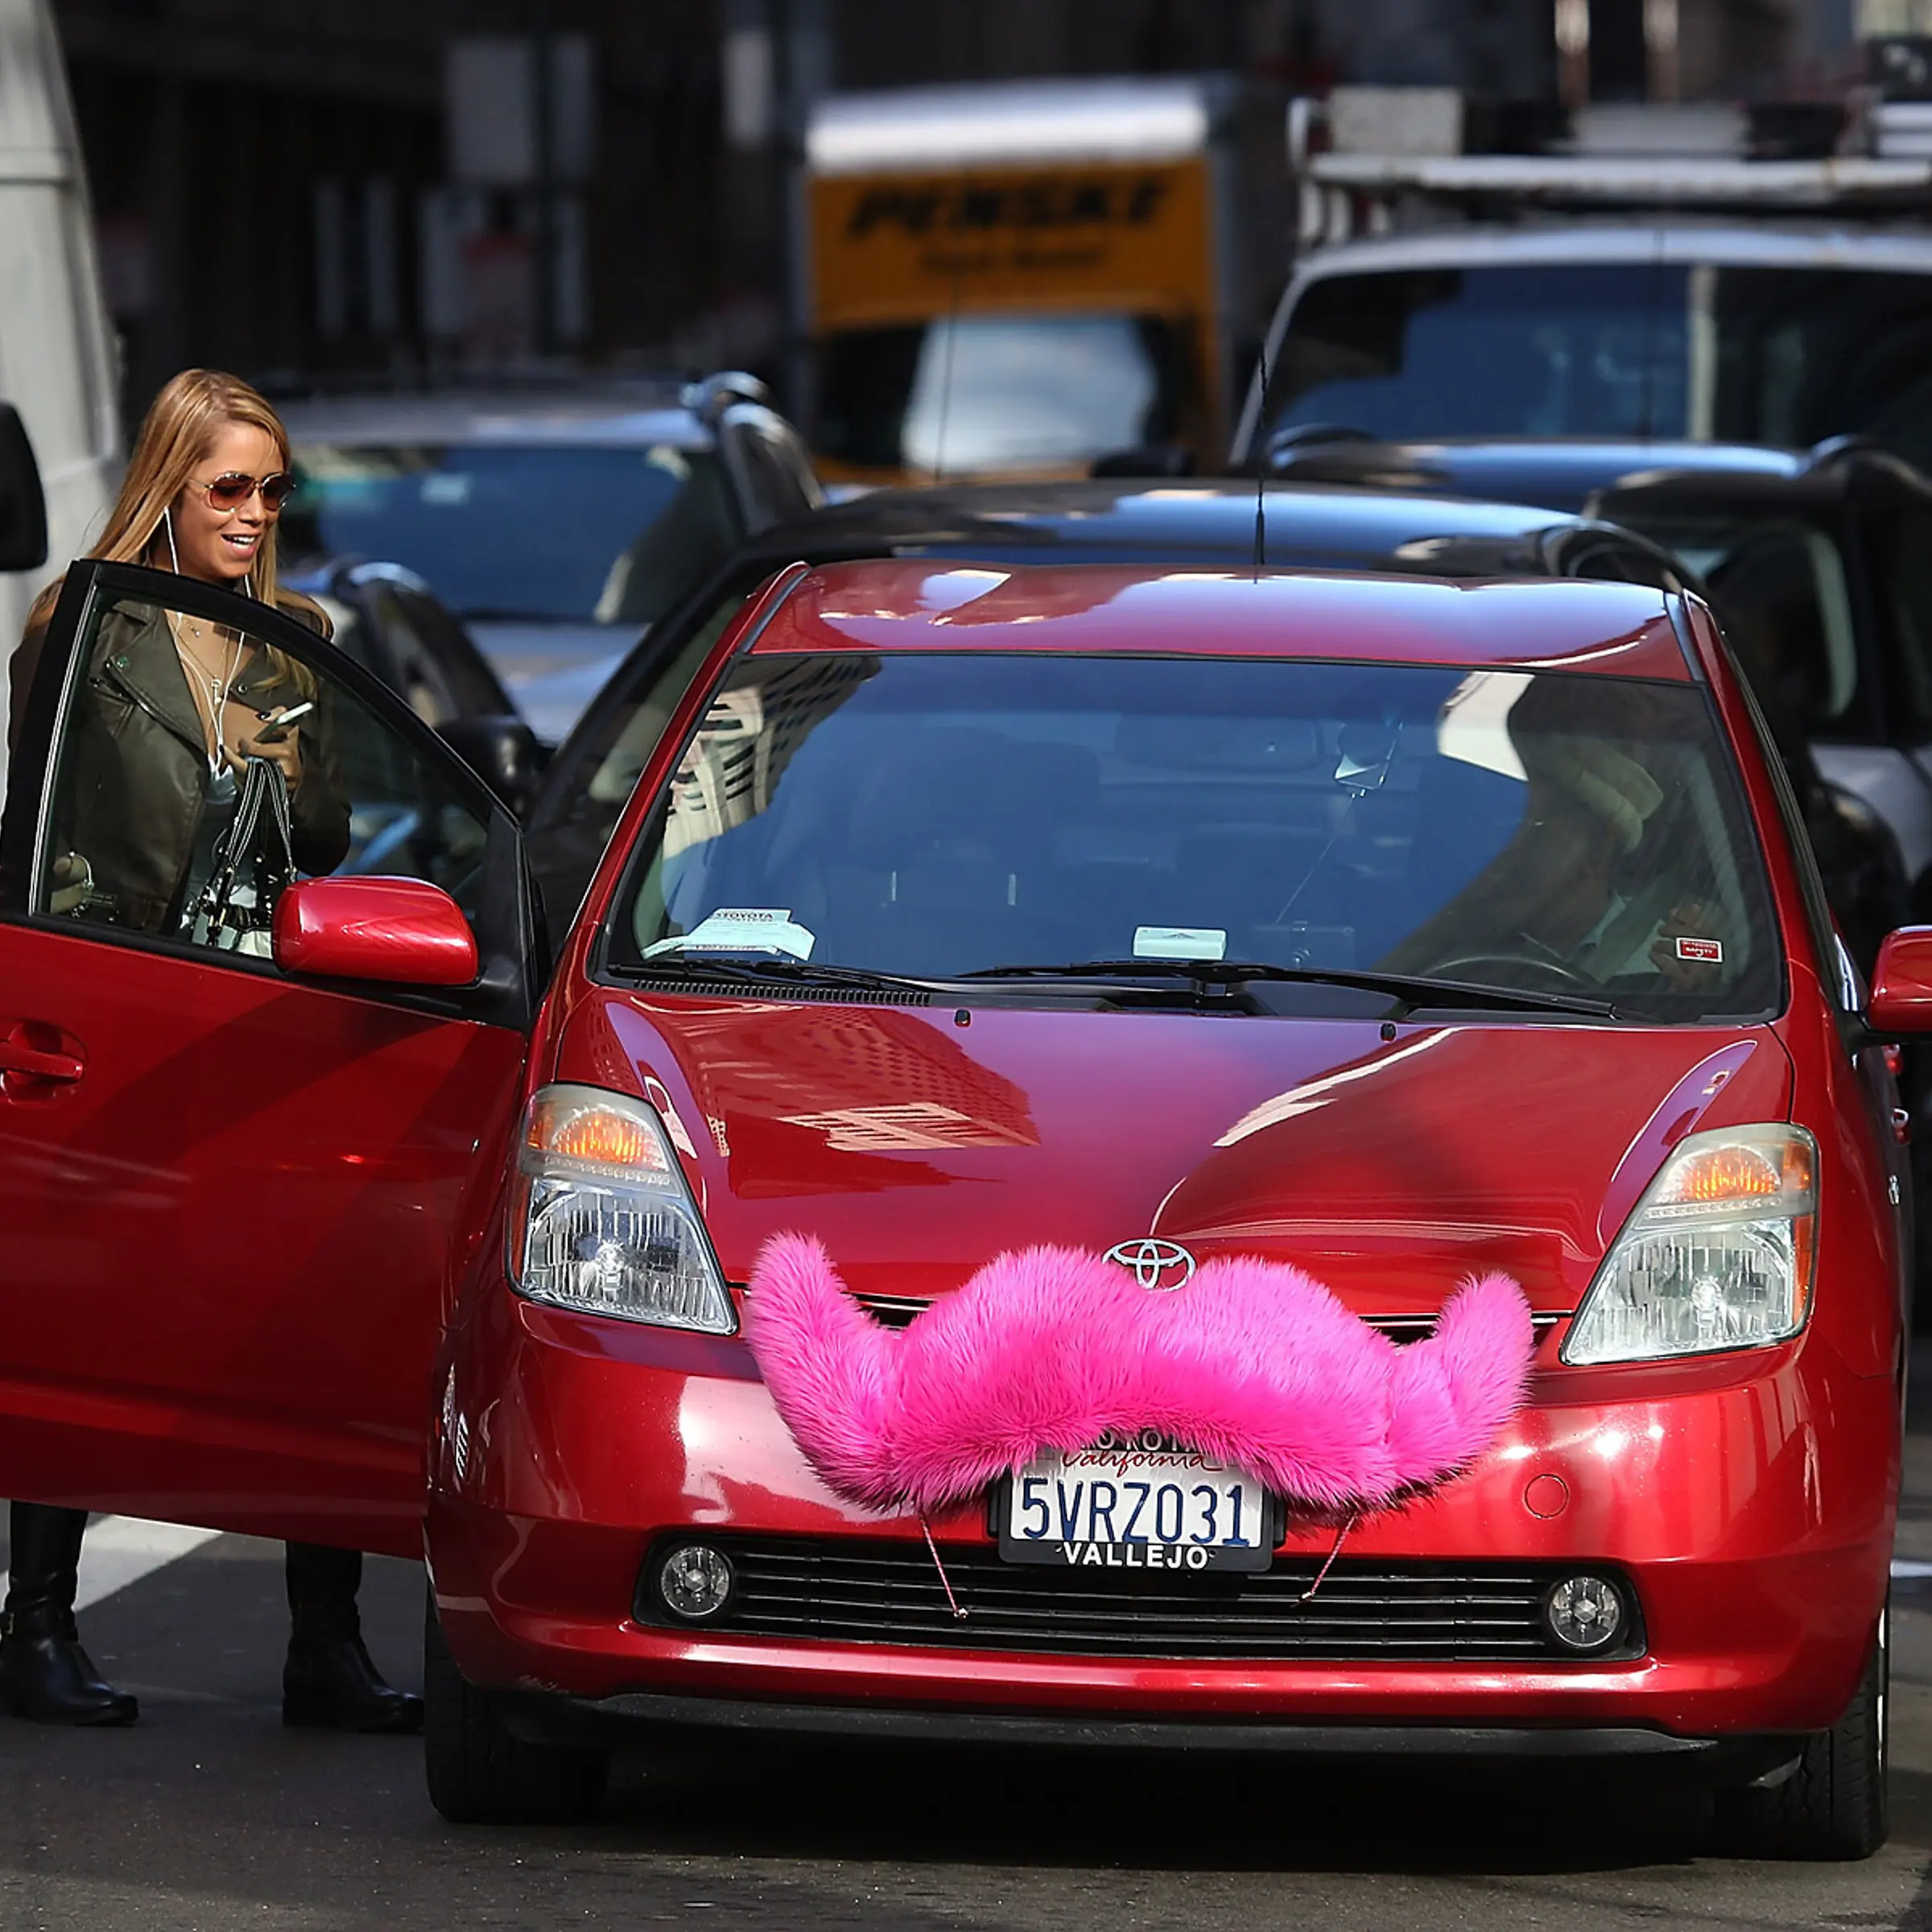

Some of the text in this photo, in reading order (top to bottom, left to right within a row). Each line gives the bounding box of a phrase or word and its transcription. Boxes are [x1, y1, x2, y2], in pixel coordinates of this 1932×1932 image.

[1062, 1449, 1224, 1478] California
[1022, 1478, 1250, 1546] 5VRZ031
[1063, 1541, 1209, 1570] VALLEJO
